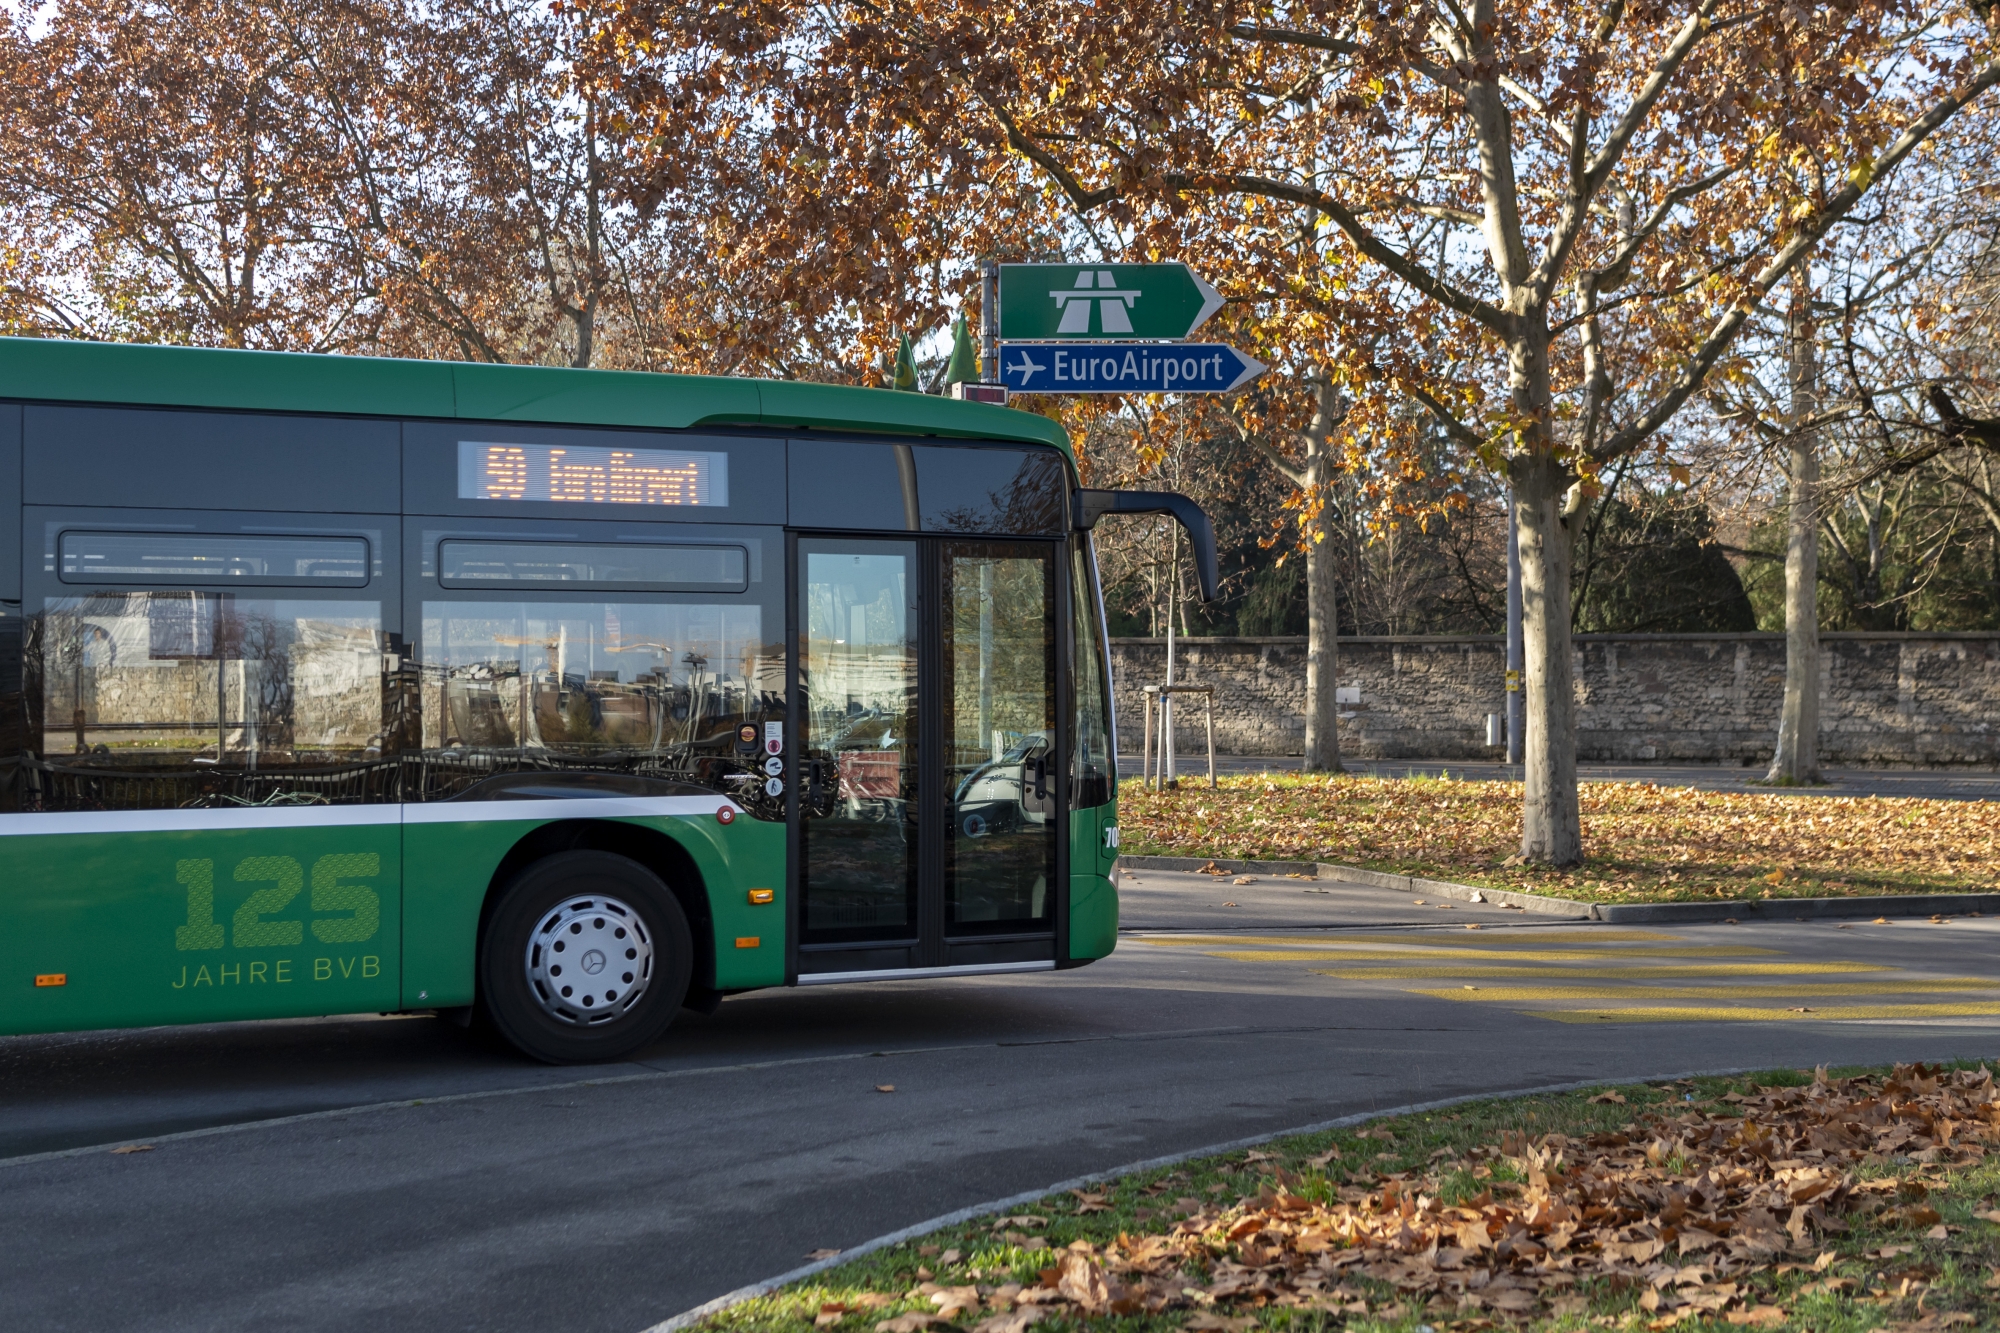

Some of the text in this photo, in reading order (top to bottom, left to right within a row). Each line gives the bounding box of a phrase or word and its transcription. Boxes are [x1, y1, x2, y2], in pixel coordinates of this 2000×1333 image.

[1055, 350, 1223, 389] EuroAirport
[1105, 827, 1119, 848] 70
[175, 853, 380, 951] 125
[172, 955, 380, 989] JAHRE BVB
